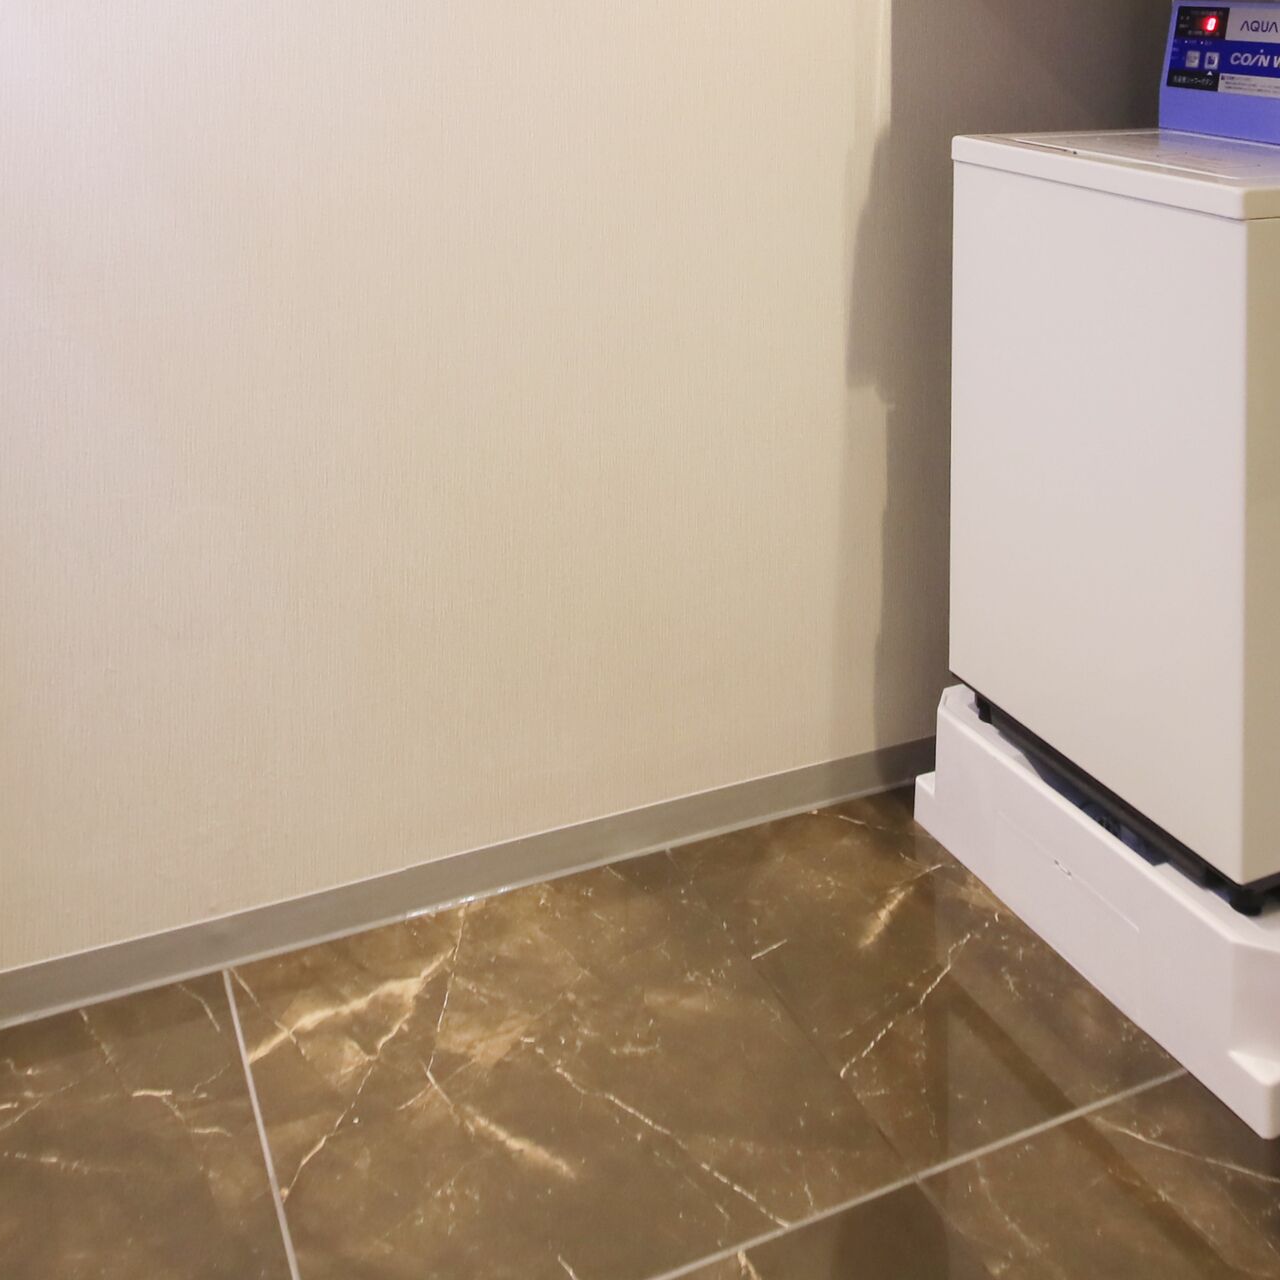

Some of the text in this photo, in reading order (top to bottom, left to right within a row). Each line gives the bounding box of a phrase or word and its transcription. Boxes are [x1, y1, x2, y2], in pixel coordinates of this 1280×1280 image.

[1207, 17, 1217, 31] 0
[1240, 20, 1278, 33] AQUA
[1230, 48, 1270, 67] COIN
